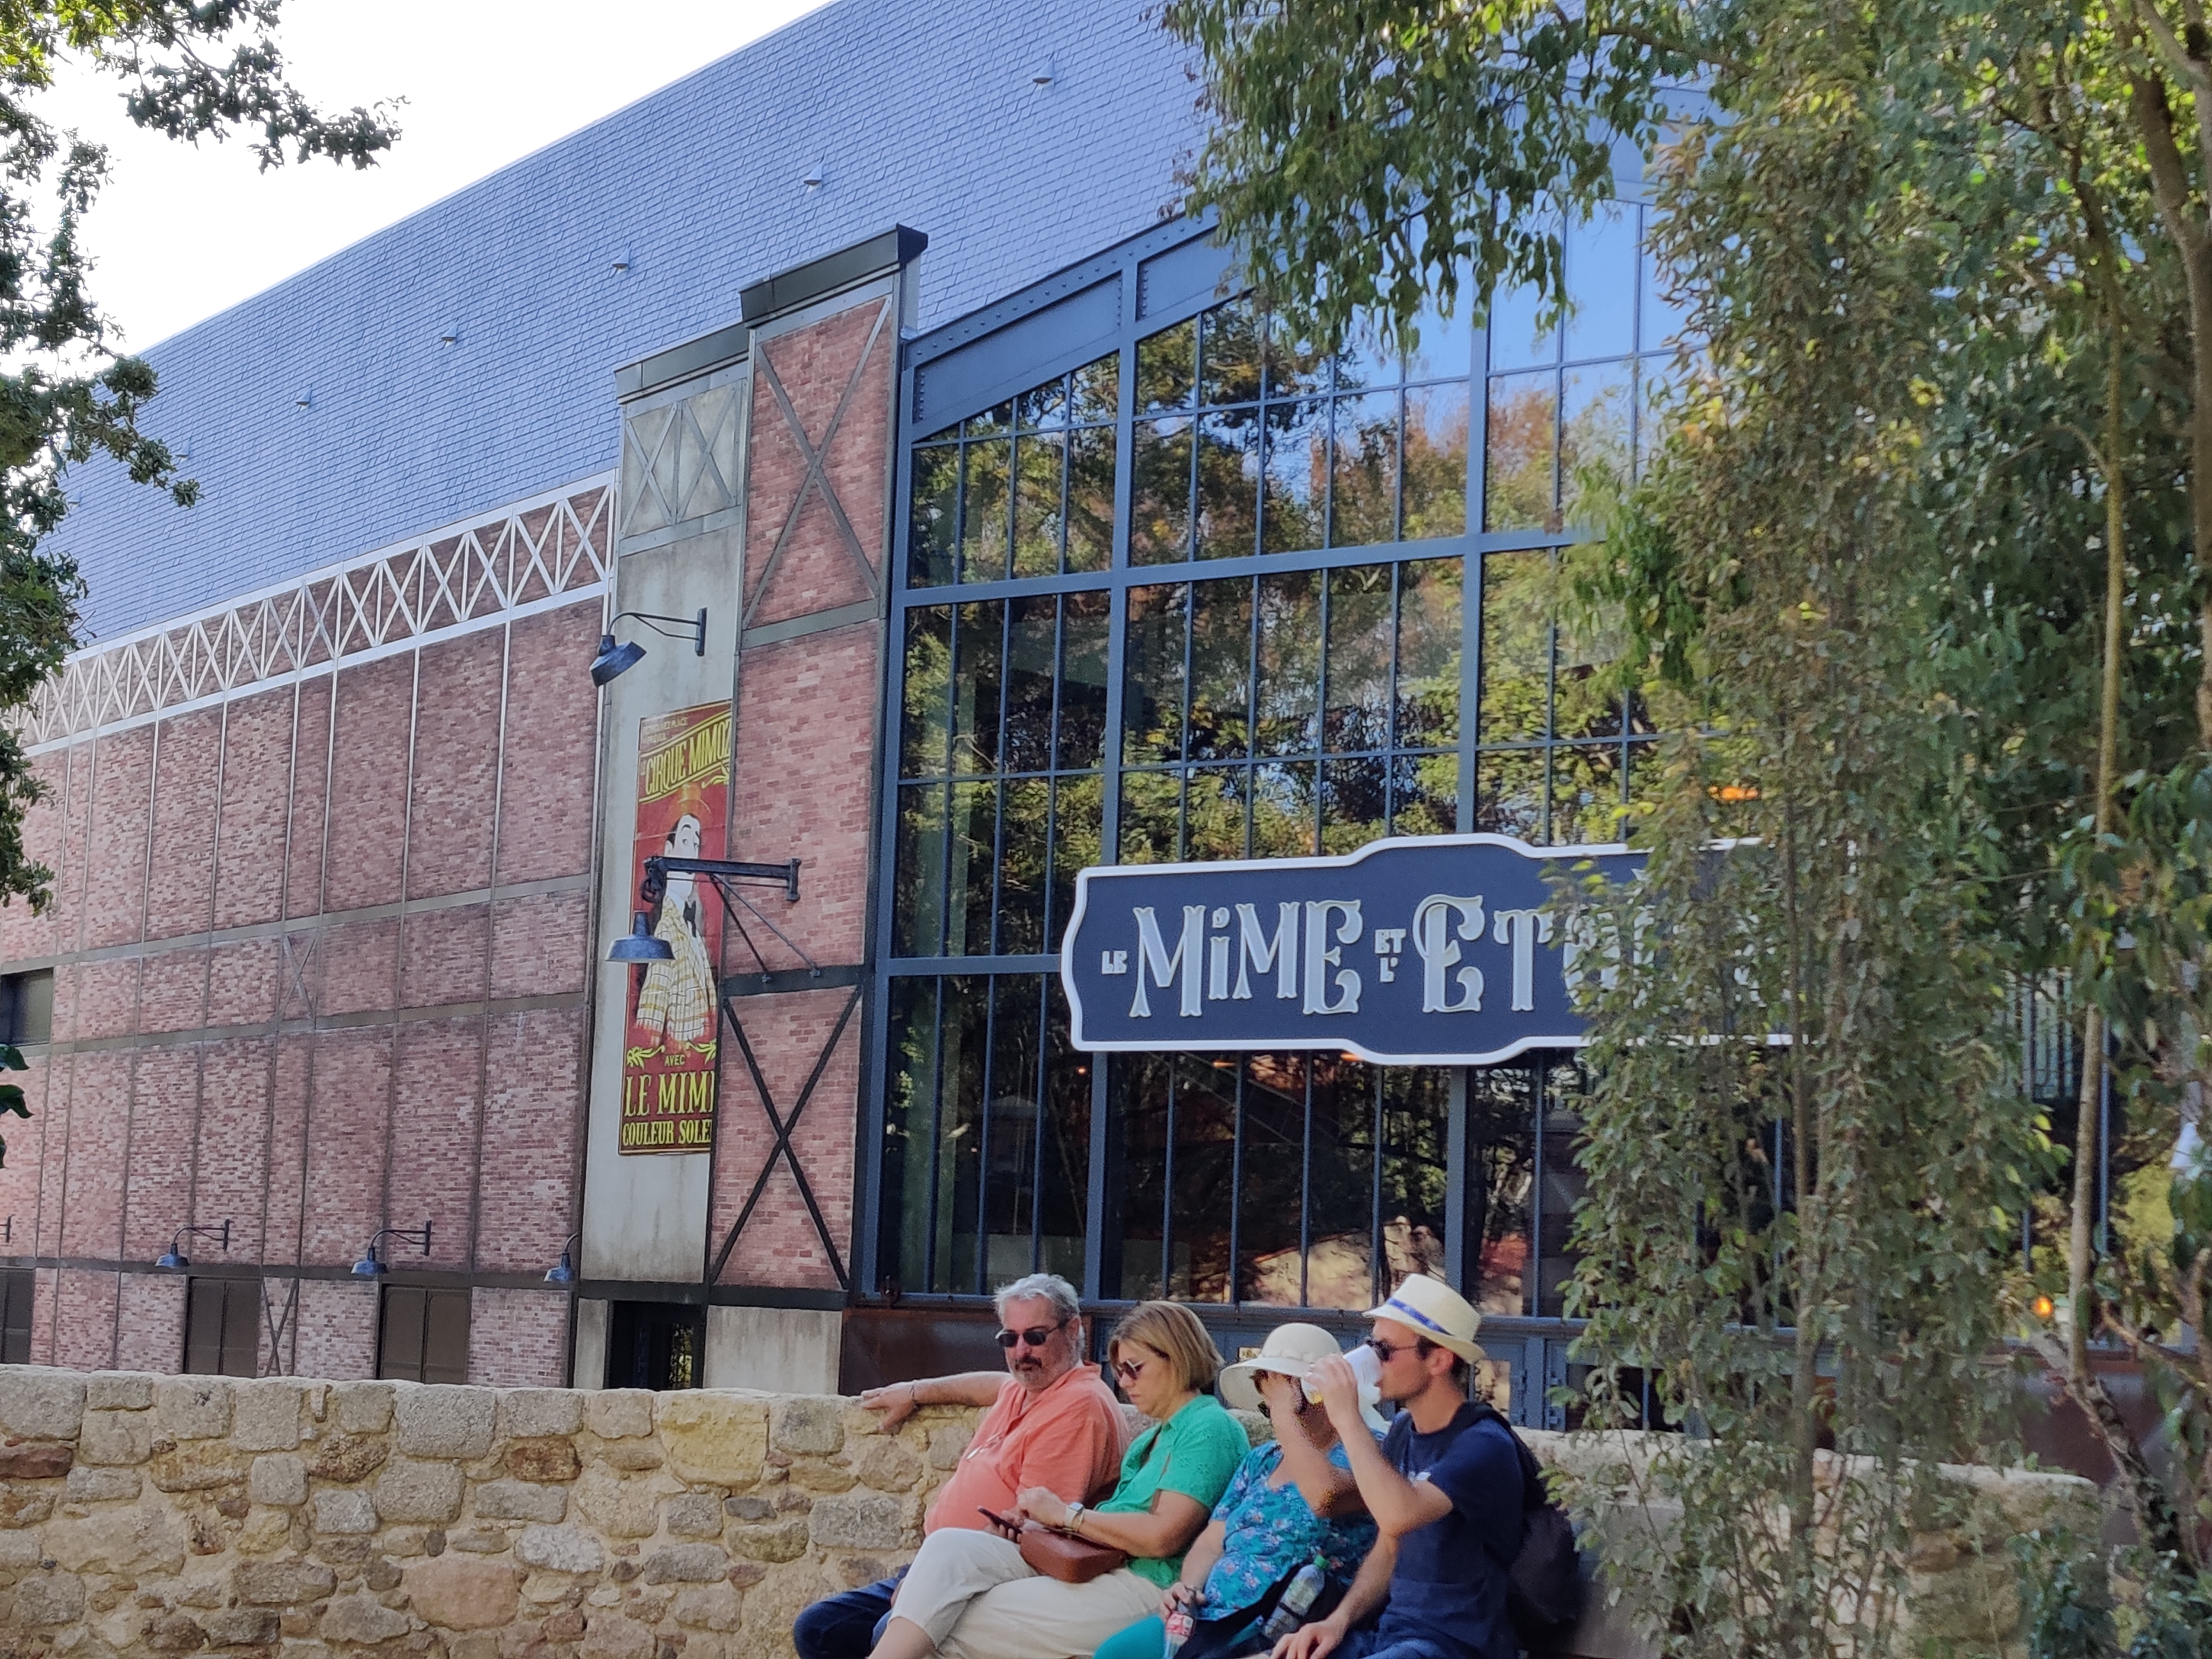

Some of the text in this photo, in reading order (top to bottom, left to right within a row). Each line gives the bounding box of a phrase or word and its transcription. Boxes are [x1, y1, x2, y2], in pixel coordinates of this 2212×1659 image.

[645, 740, 687, 795] CIRQUE
[1101, 950, 1127, 974] LE
[1374, 928, 1406, 954] ET
[1379, 957, 1399, 983] L'
[665, 1054, 685, 1067] AVEC
[624, 1074, 651, 1117] LE
[623, 1120, 674, 1146] COULEUR
